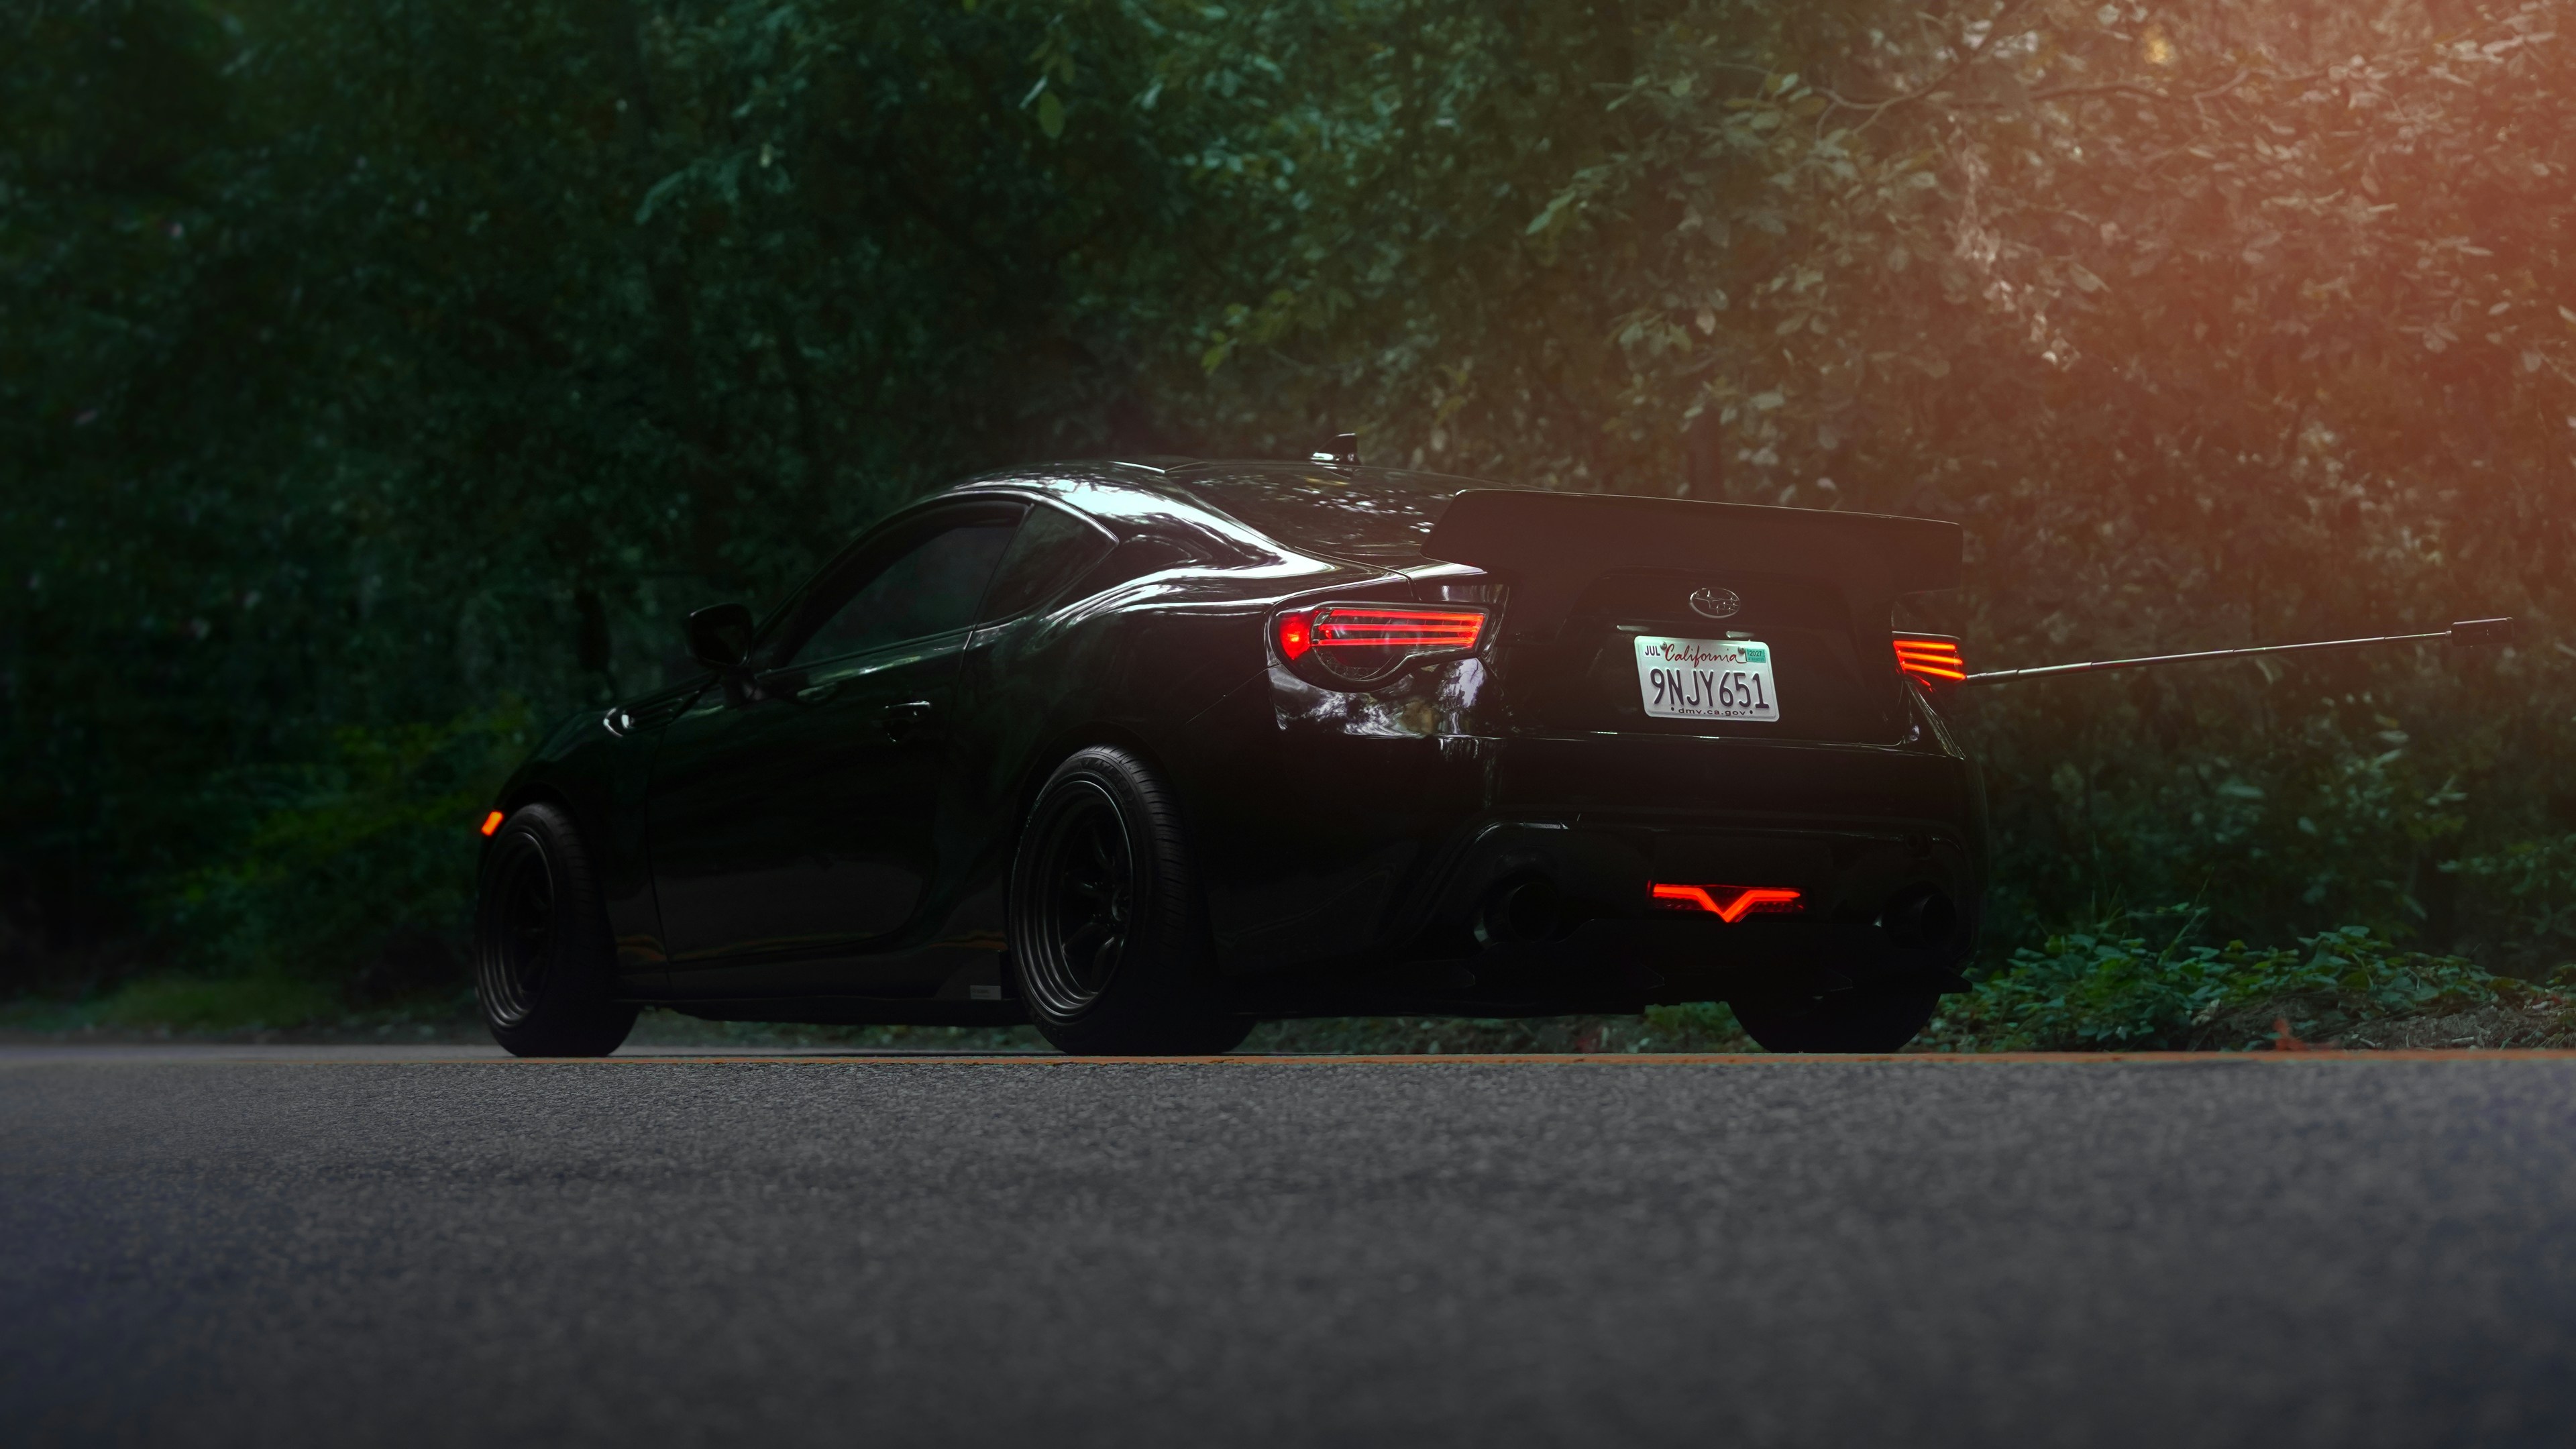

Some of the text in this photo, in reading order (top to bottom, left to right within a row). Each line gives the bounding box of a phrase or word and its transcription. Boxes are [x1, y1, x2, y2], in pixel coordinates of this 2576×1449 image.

[1645, 646, 1660, 656] JUL
[1665, 643, 1747, 668] California
[1650, 668, 1769, 708] 9NJY651
[1678, 708, 1746, 716] dmv.ca.gov
